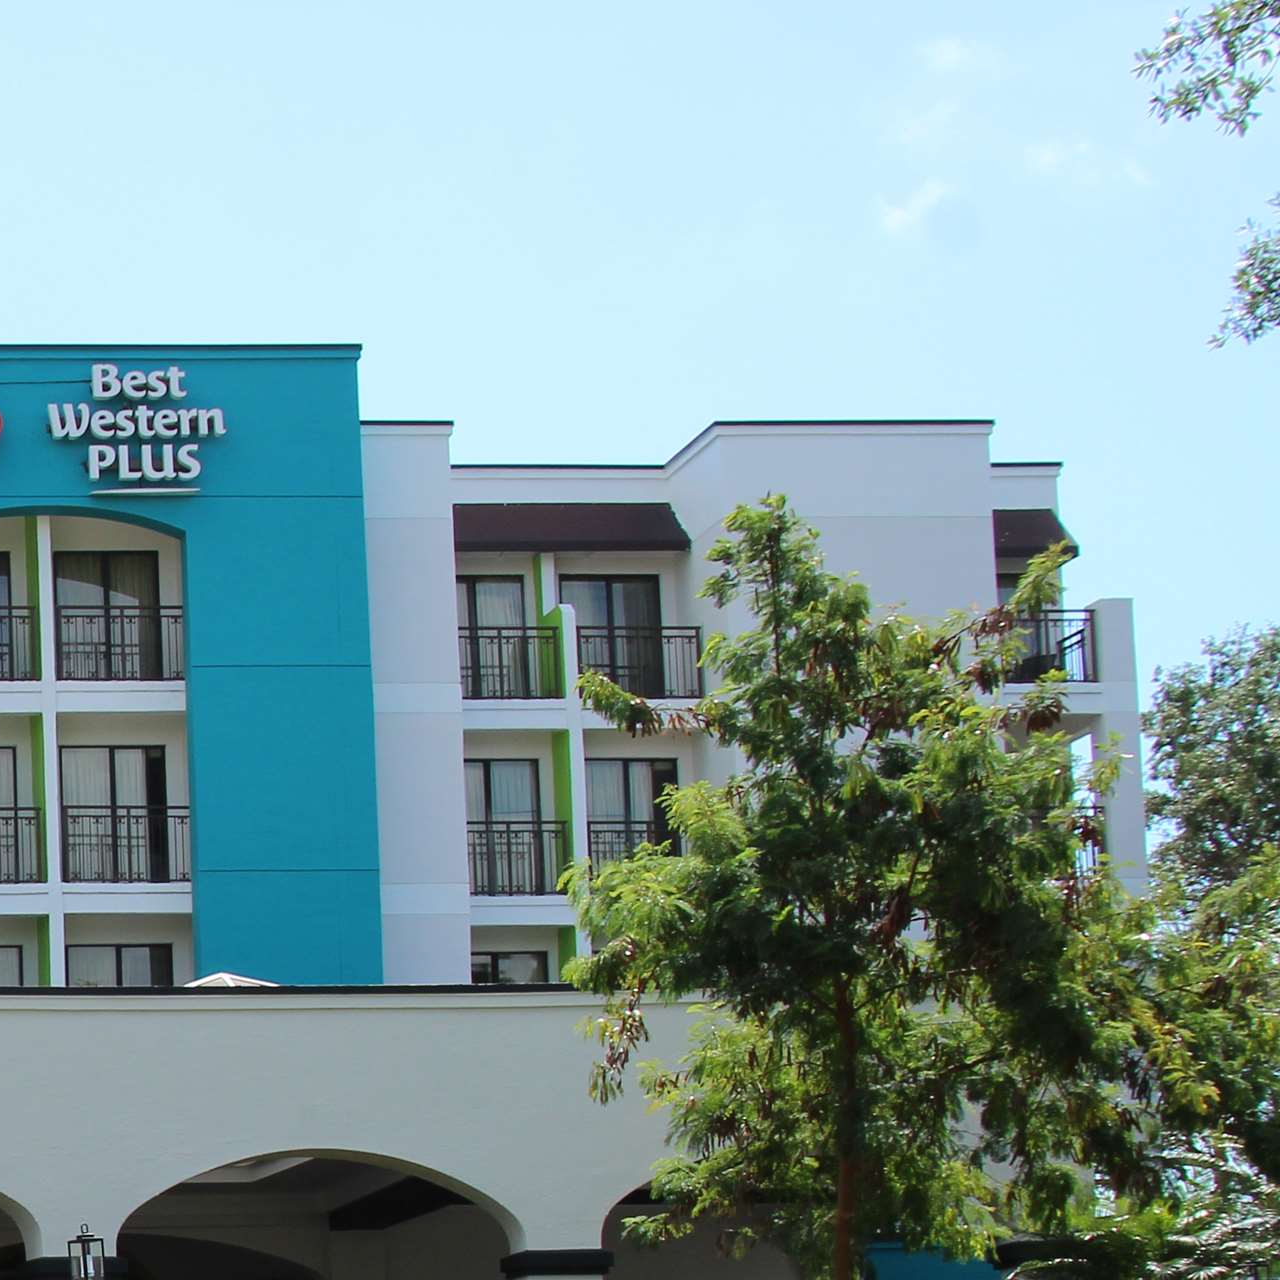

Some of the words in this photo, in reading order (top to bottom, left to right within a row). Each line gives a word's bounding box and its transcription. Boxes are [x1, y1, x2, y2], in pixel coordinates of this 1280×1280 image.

[91, 363, 188, 399] Best
[47, 403, 227, 440] Western
[88, 444, 202, 481] PLUS
